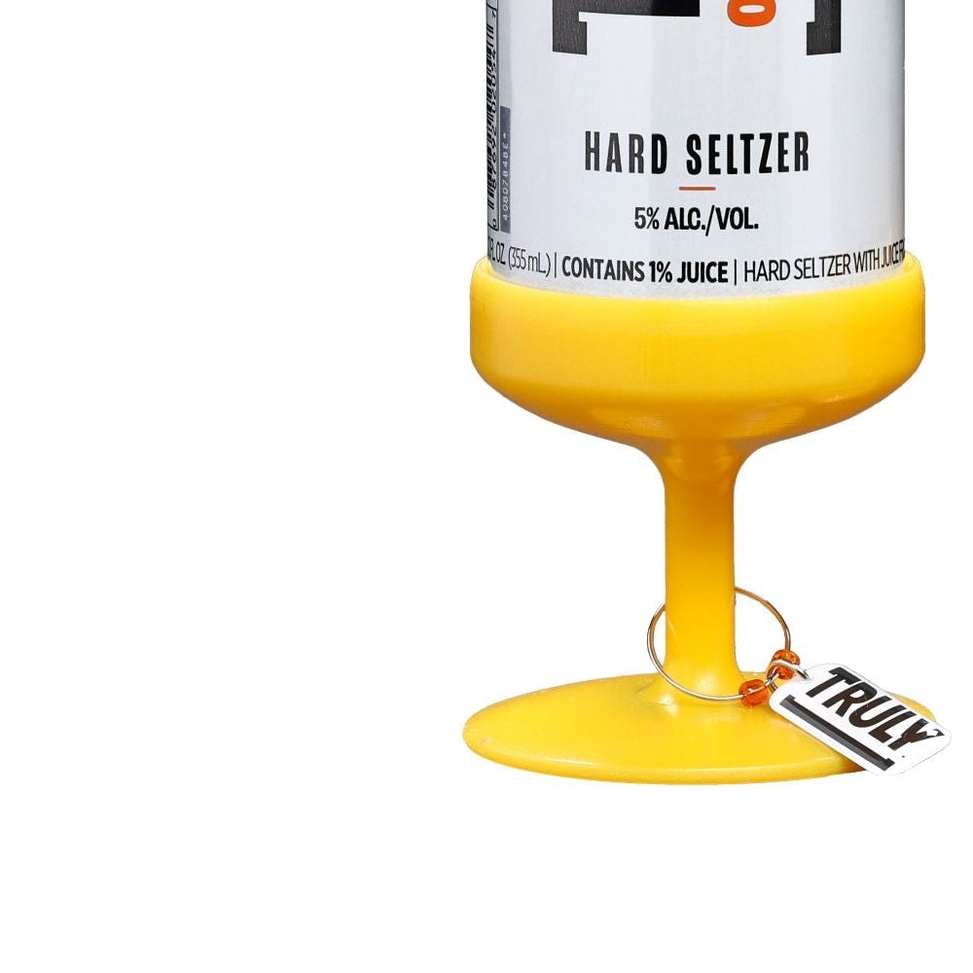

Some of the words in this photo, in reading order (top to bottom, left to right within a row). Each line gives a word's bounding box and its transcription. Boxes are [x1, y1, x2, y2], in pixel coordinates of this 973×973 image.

[585, 131, 667, 174] HARD
[686, 131, 808, 175] SELTZER
[634, 207, 660, 230] 5%
[664, 205, 759, 237] ALC./VOL.
[496, 241, 506, 265] OZ
[562, 256, 645, 282] CONTAINS
[649, 261, 673, 283] 1%
[677, 261, 728, 283] JUICE
[744, 260, 791, 282] HARD
[794, 253, 851, 280] SELTZER
[853, 251, 880, 274] WITH
[881, 241, 899, 268] JUICE
[806, 667, 945, 751] TRULY
